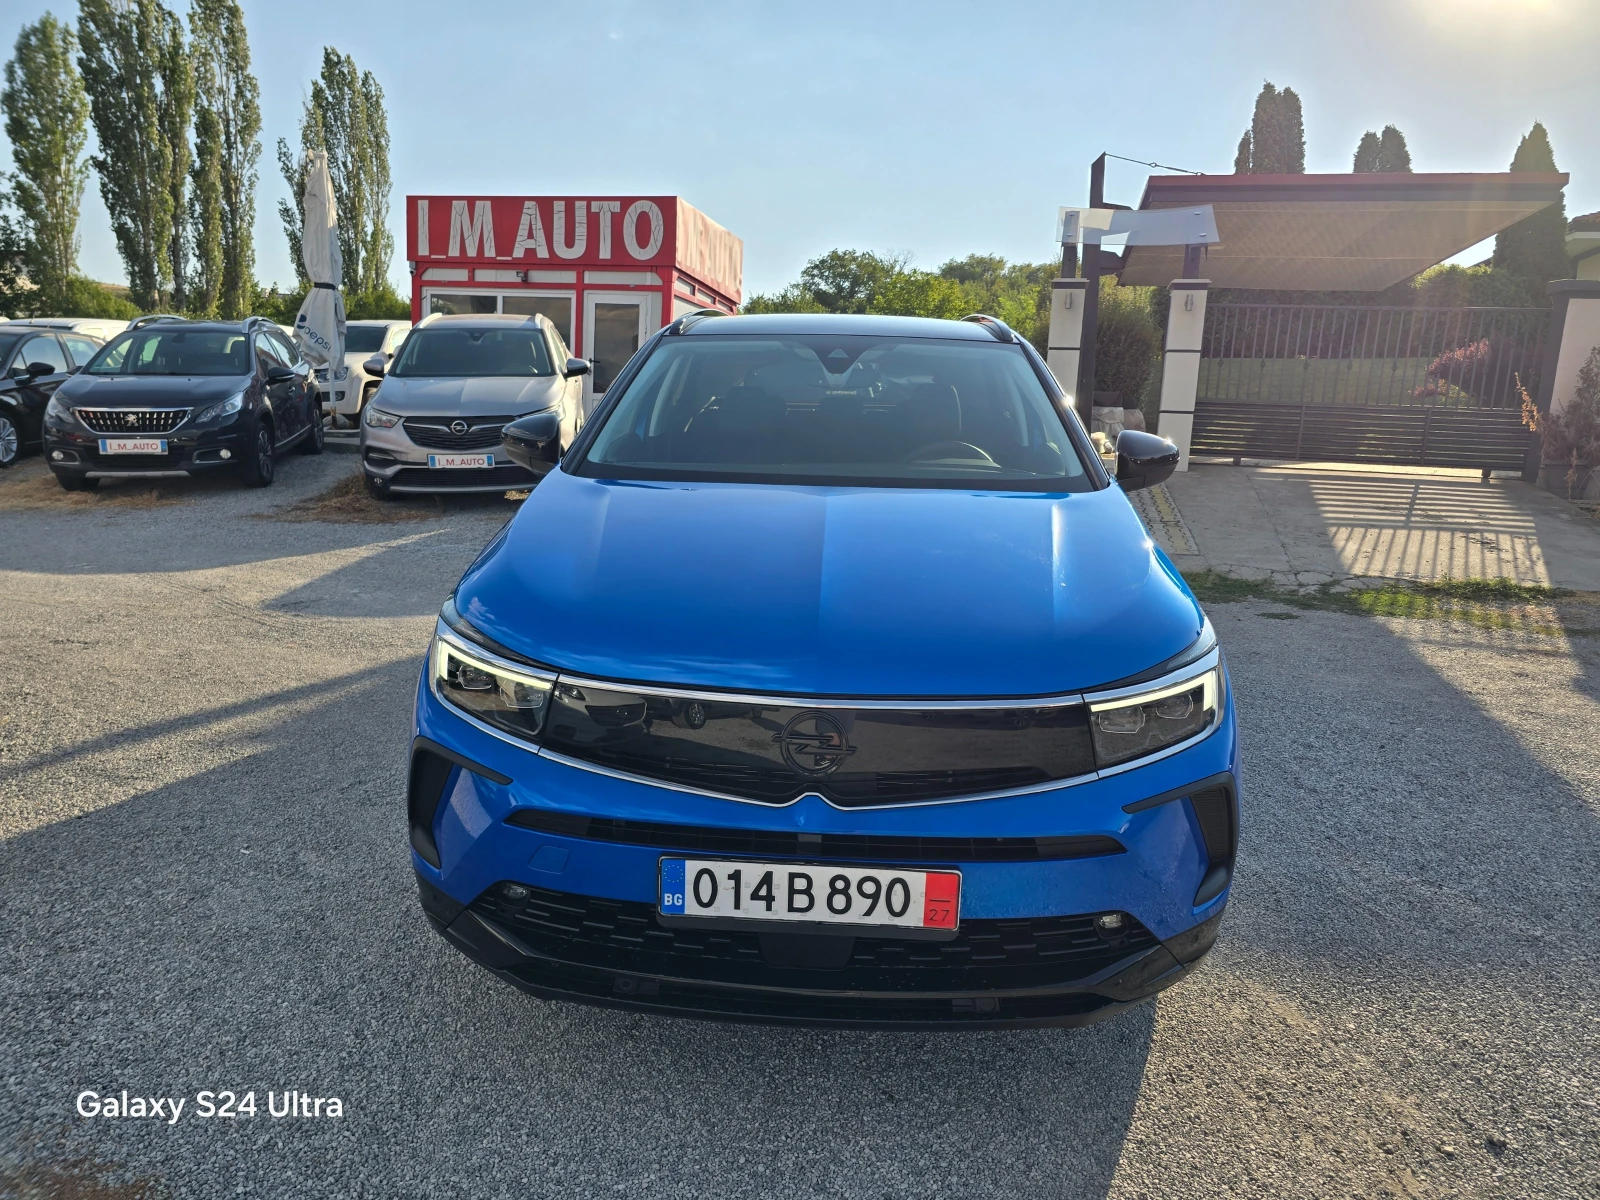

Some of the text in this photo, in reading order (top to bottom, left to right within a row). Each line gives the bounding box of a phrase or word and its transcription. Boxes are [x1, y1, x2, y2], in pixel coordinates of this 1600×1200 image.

[303, 326, 332, 351] pepsi
[664, 893, 683, 906] BG
[929, 908, 950, 922] 27
